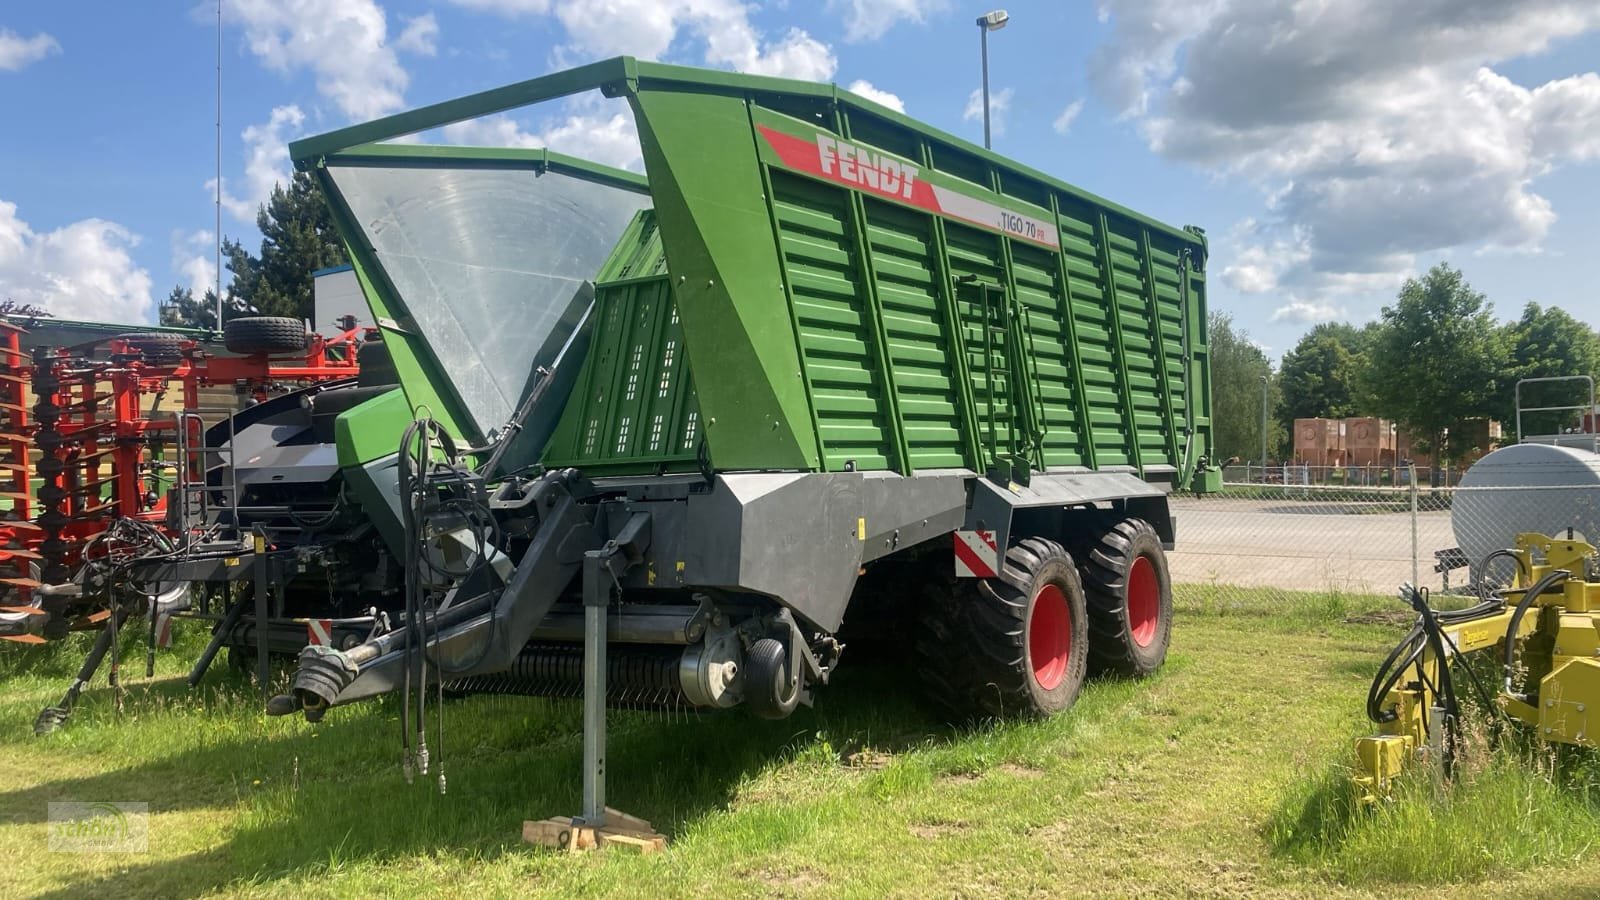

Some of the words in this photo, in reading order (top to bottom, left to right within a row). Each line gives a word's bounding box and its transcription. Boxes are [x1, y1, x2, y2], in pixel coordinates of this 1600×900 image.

[816, 133, 919, 199] FENDT
[1001, 212, 1023, 233] TIGO
[1025, 221, 1036, 238] 70
